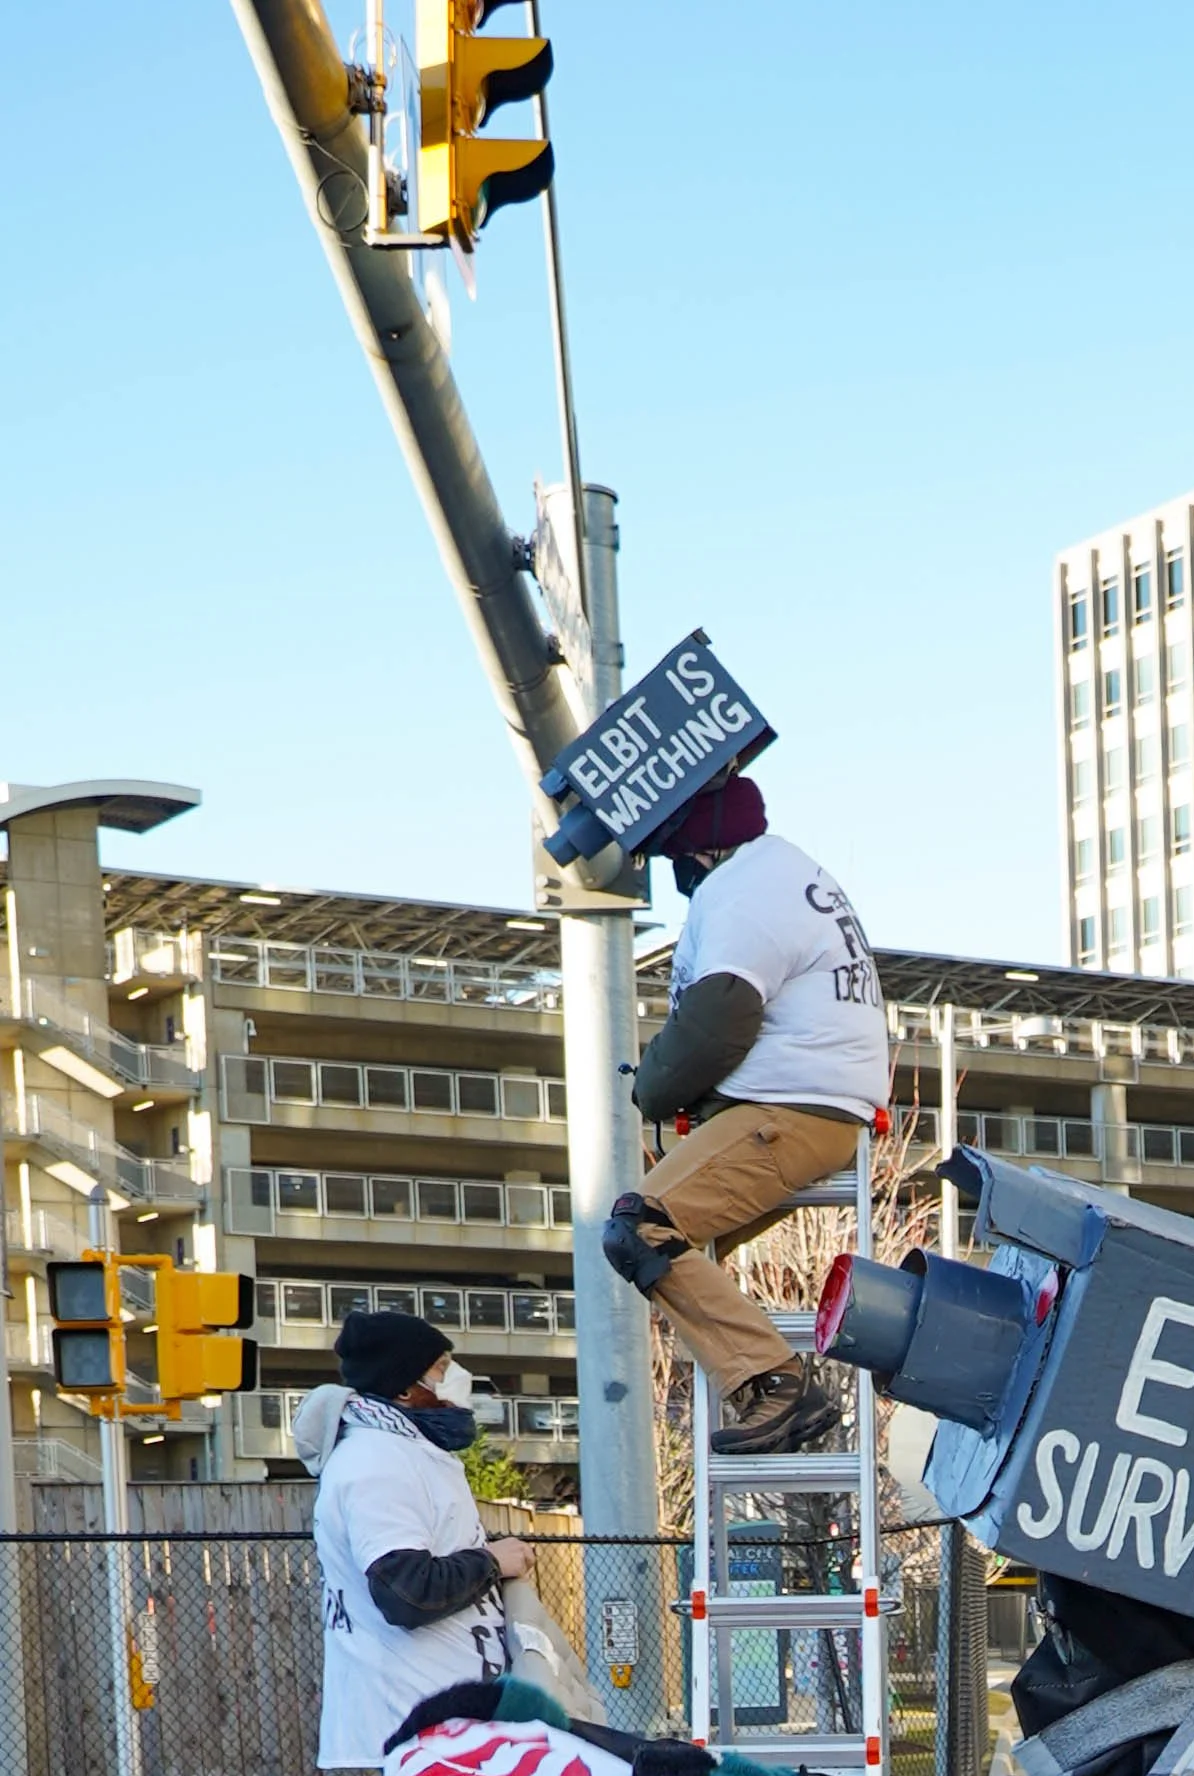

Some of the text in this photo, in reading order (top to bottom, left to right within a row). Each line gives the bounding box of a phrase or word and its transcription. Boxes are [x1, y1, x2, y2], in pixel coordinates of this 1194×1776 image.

[568, 651, 715, 801] ELBIT IS
[595, 692, 753, 836] WATCHING
